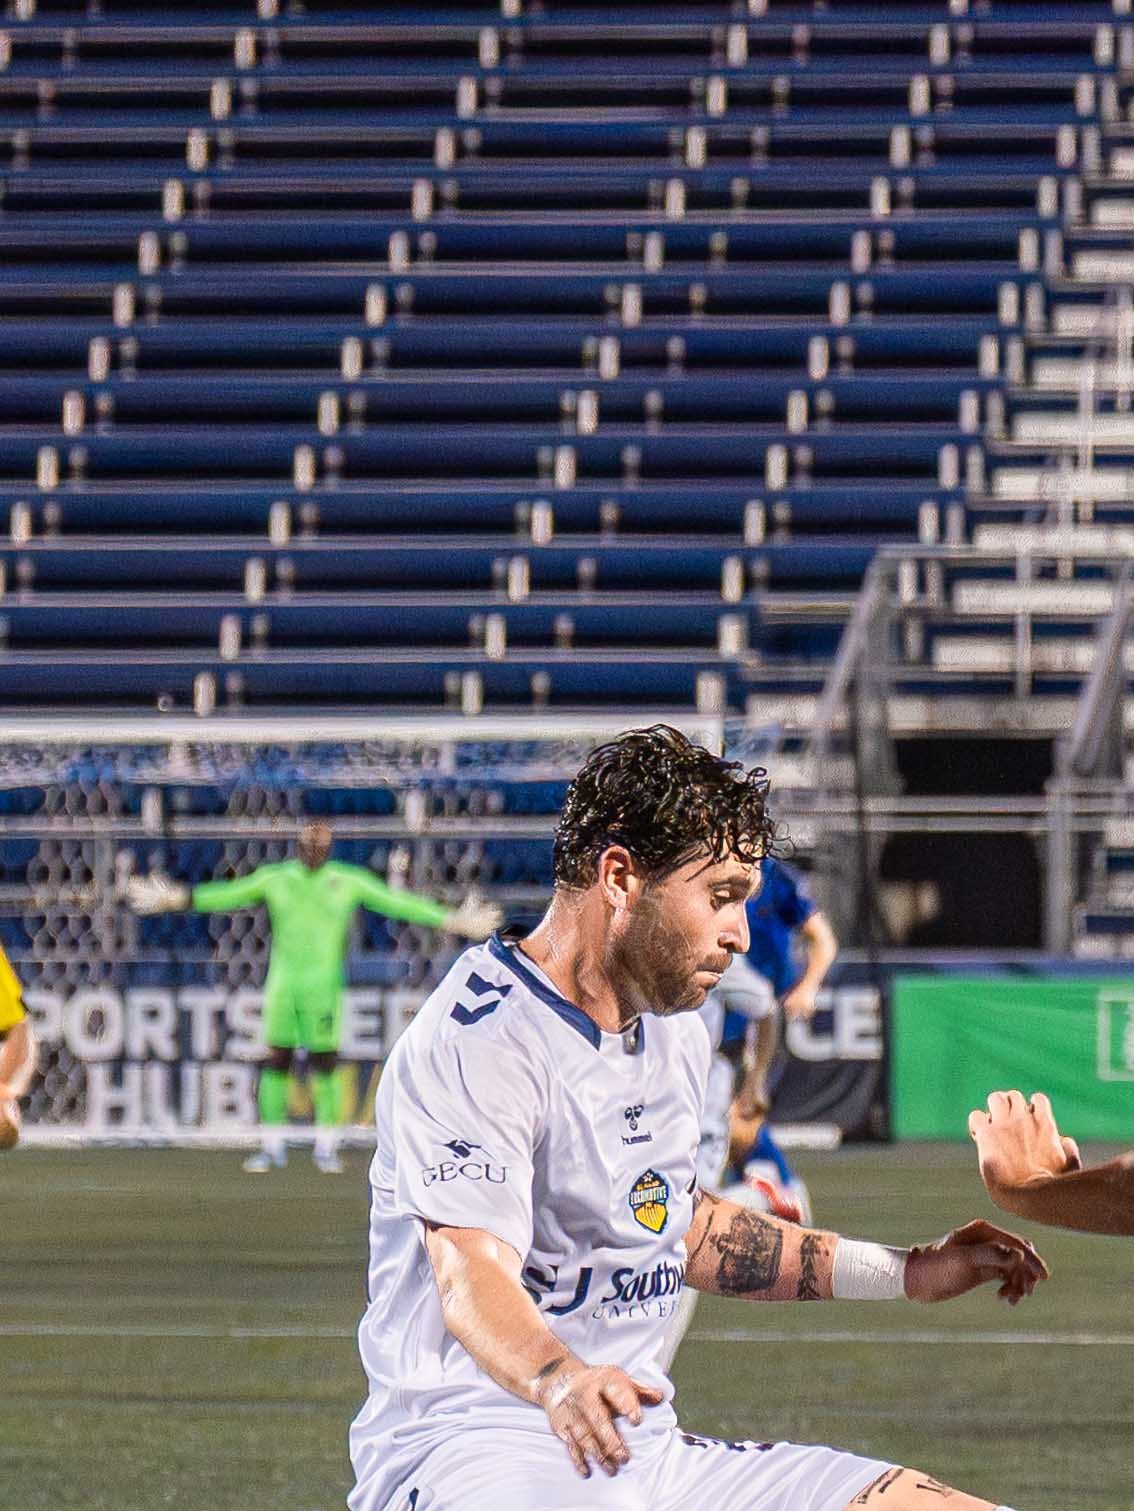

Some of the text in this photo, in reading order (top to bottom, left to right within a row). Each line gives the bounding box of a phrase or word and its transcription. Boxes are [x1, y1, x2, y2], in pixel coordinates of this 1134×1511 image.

[24, 988, 268, 1061] PORTS
[89, 1062, 258, 1129] HUB
[423, 1161, 508, 1187] GECU
